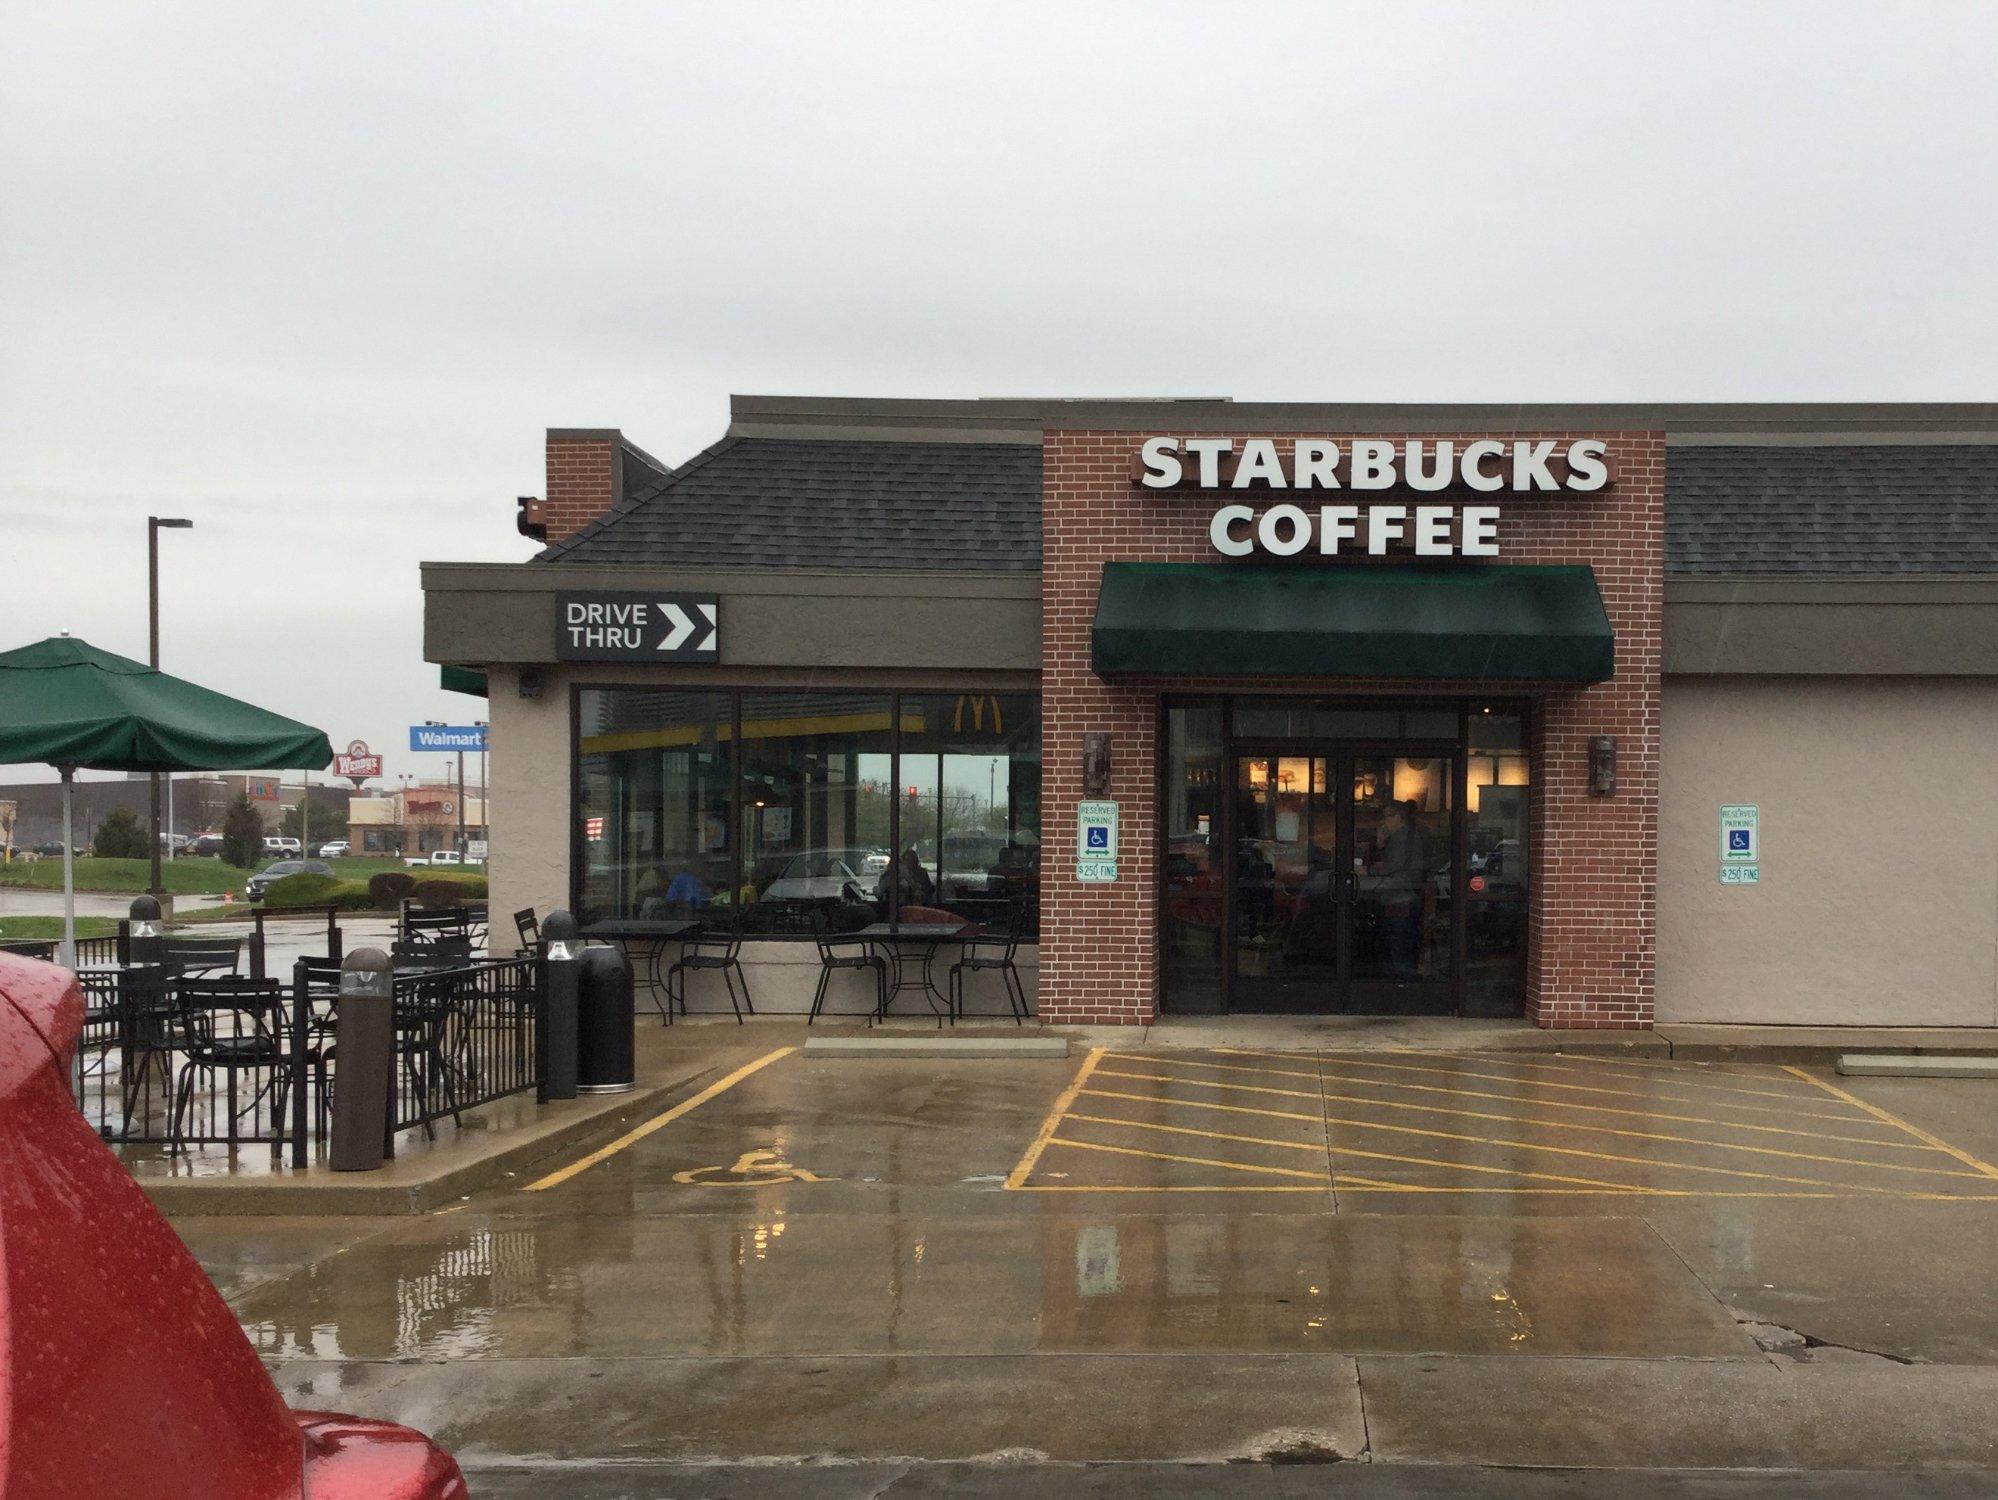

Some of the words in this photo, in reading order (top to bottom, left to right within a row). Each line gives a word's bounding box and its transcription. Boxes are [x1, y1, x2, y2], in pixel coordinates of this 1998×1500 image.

[1140, 436, 1608, 492] STARBUCKS
[1209, 504, 1500, 557] COFFEE
[567, 603, 647, 625] DRIVE
[567, 627, 641, 649] THRU
[418, 731, 482, 746] Walmart
[1081, 806, 1115, 815] RESERVED
[1722, 810, 1757, 818] RESERVED
[1083, 816, 1113, 825] PARKING
[1725, 820, 1754, 828] PARKING
[1100, 865, 1116, 877] FINE
[1743, 868, 1759, 880] FINE
